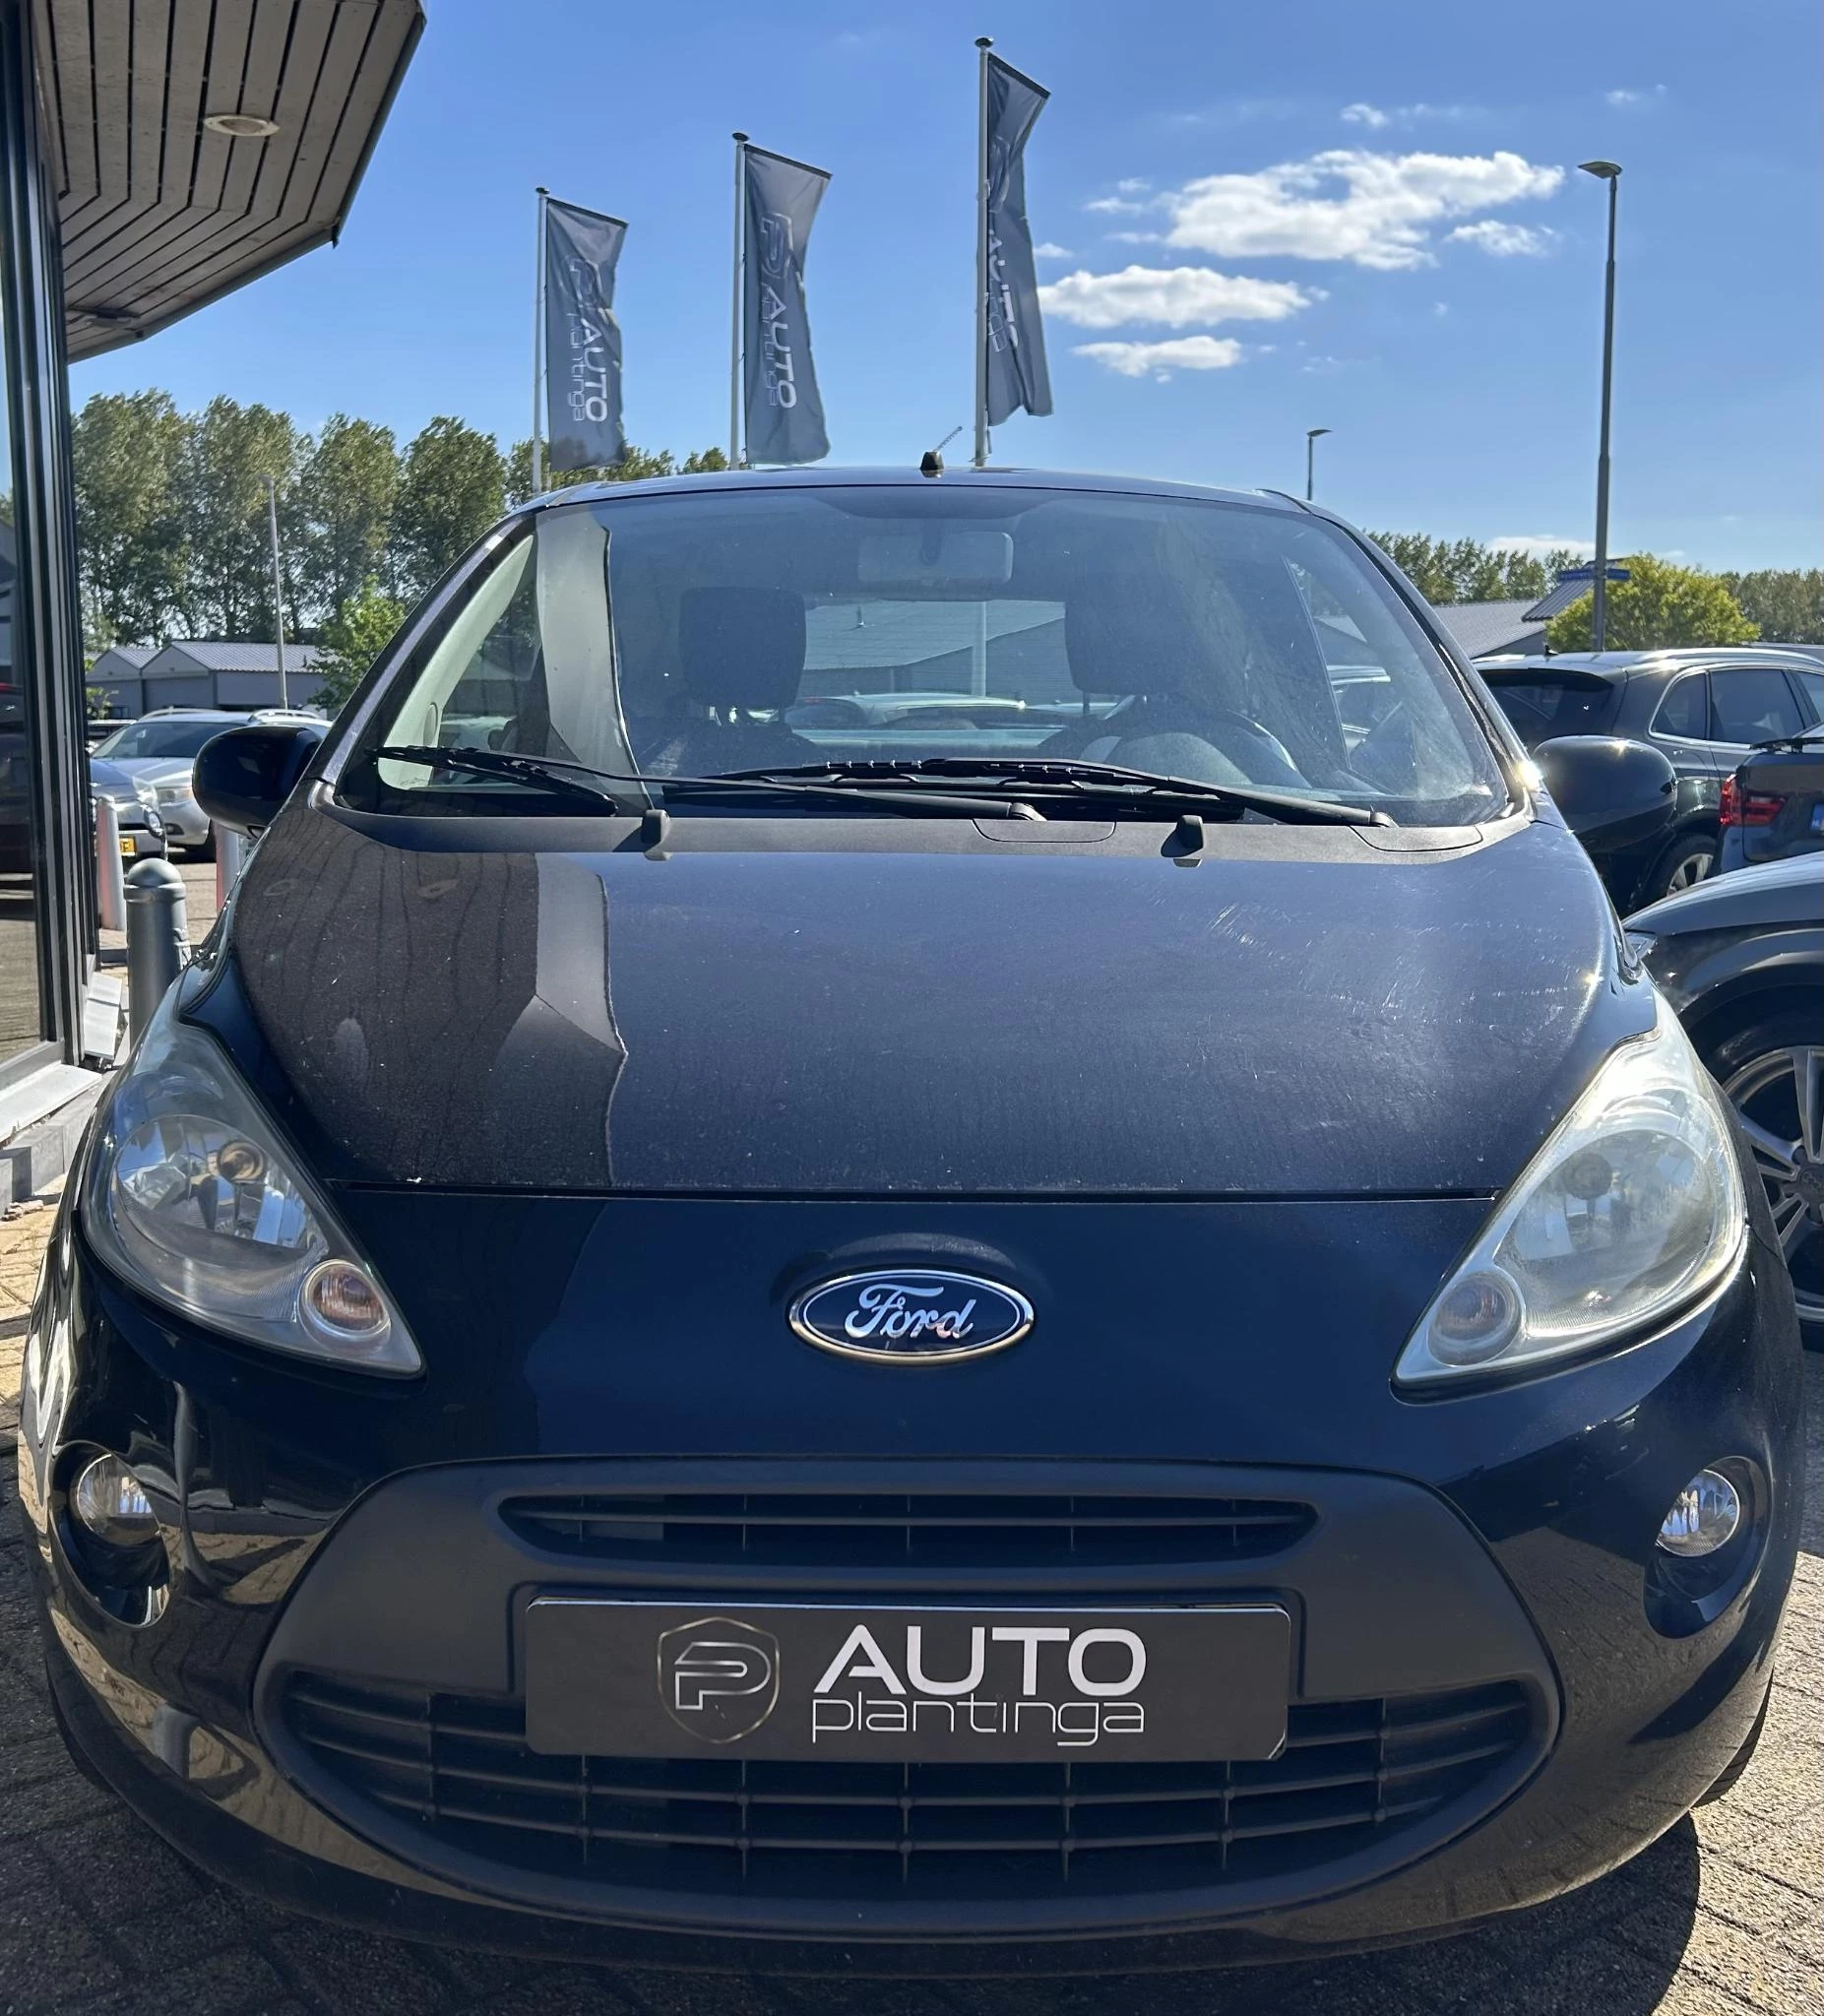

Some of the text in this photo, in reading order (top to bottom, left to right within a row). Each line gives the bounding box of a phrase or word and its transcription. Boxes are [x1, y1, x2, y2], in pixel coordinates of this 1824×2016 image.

[580, 317, 608, 422] AUTO
[768, 284, 797, 409] AUTO
[845, 1283, 977, 1339] Ford
[813, 1624, 1147, 1696] AUTO
[812, 1691, 1145, 1746] plantinga
